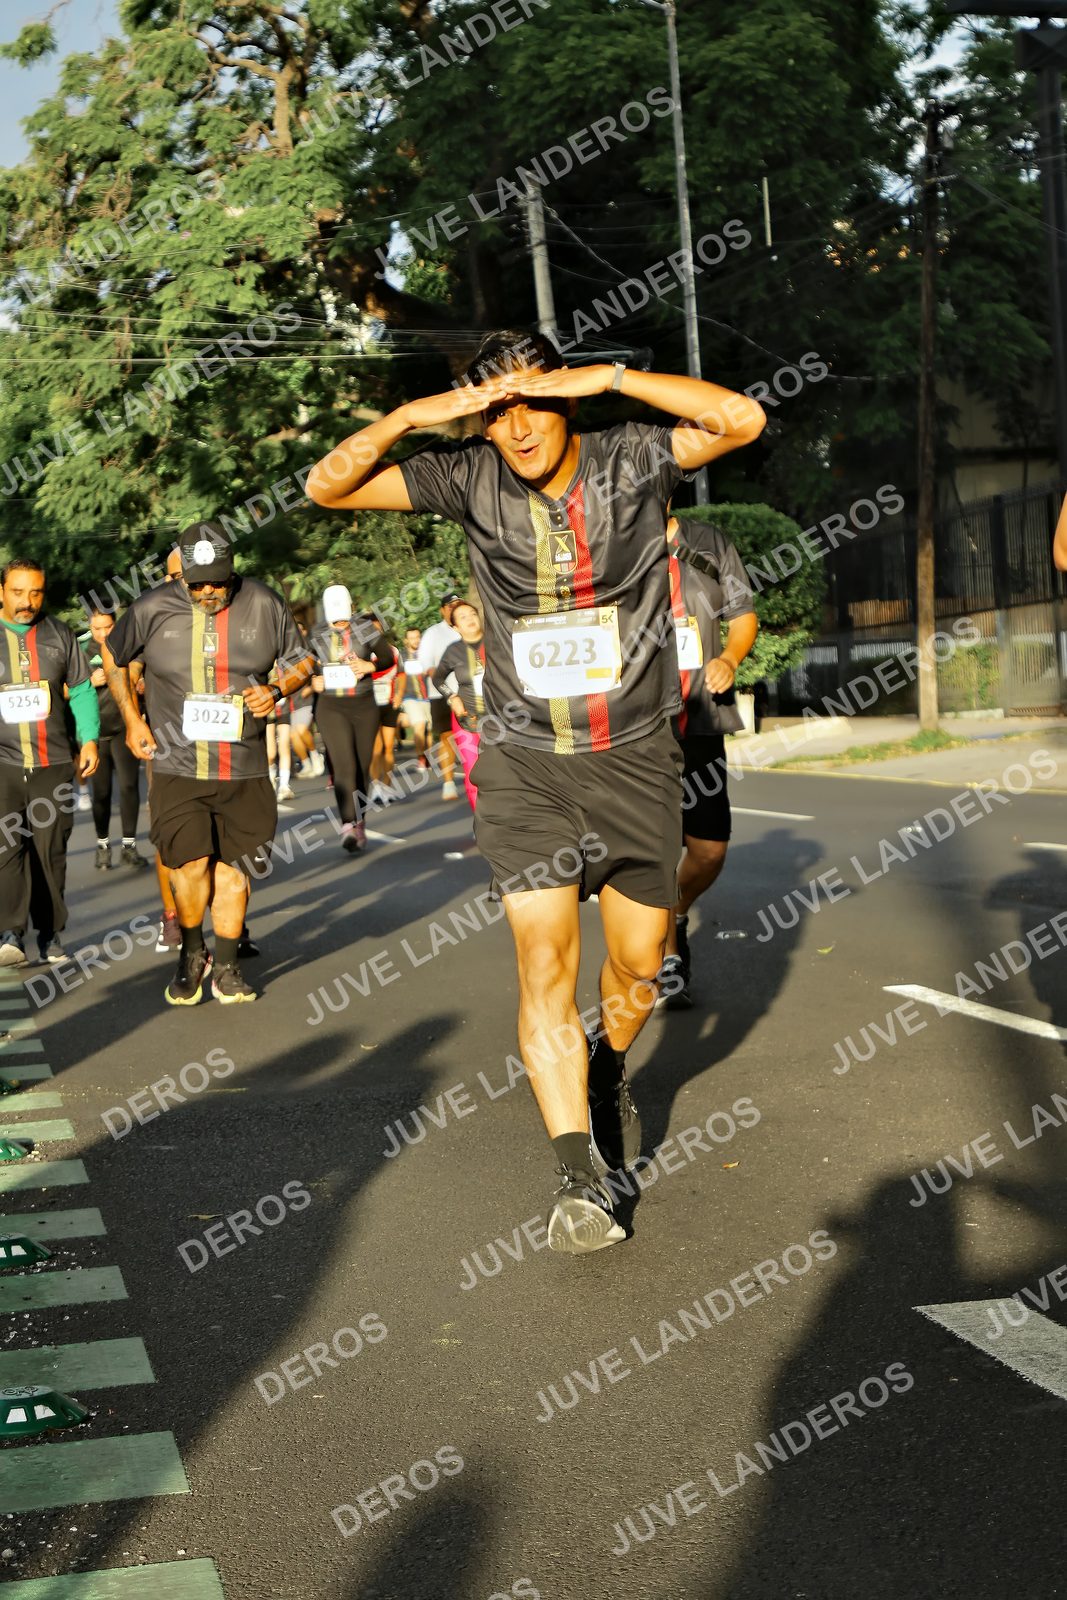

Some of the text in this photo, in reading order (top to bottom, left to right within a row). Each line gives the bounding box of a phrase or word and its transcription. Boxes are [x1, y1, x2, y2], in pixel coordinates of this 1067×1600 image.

[528, 638, 597, 669] 6223
[8, 695, 40, 708] 5254
[192, 709, 230, 724] 3022
